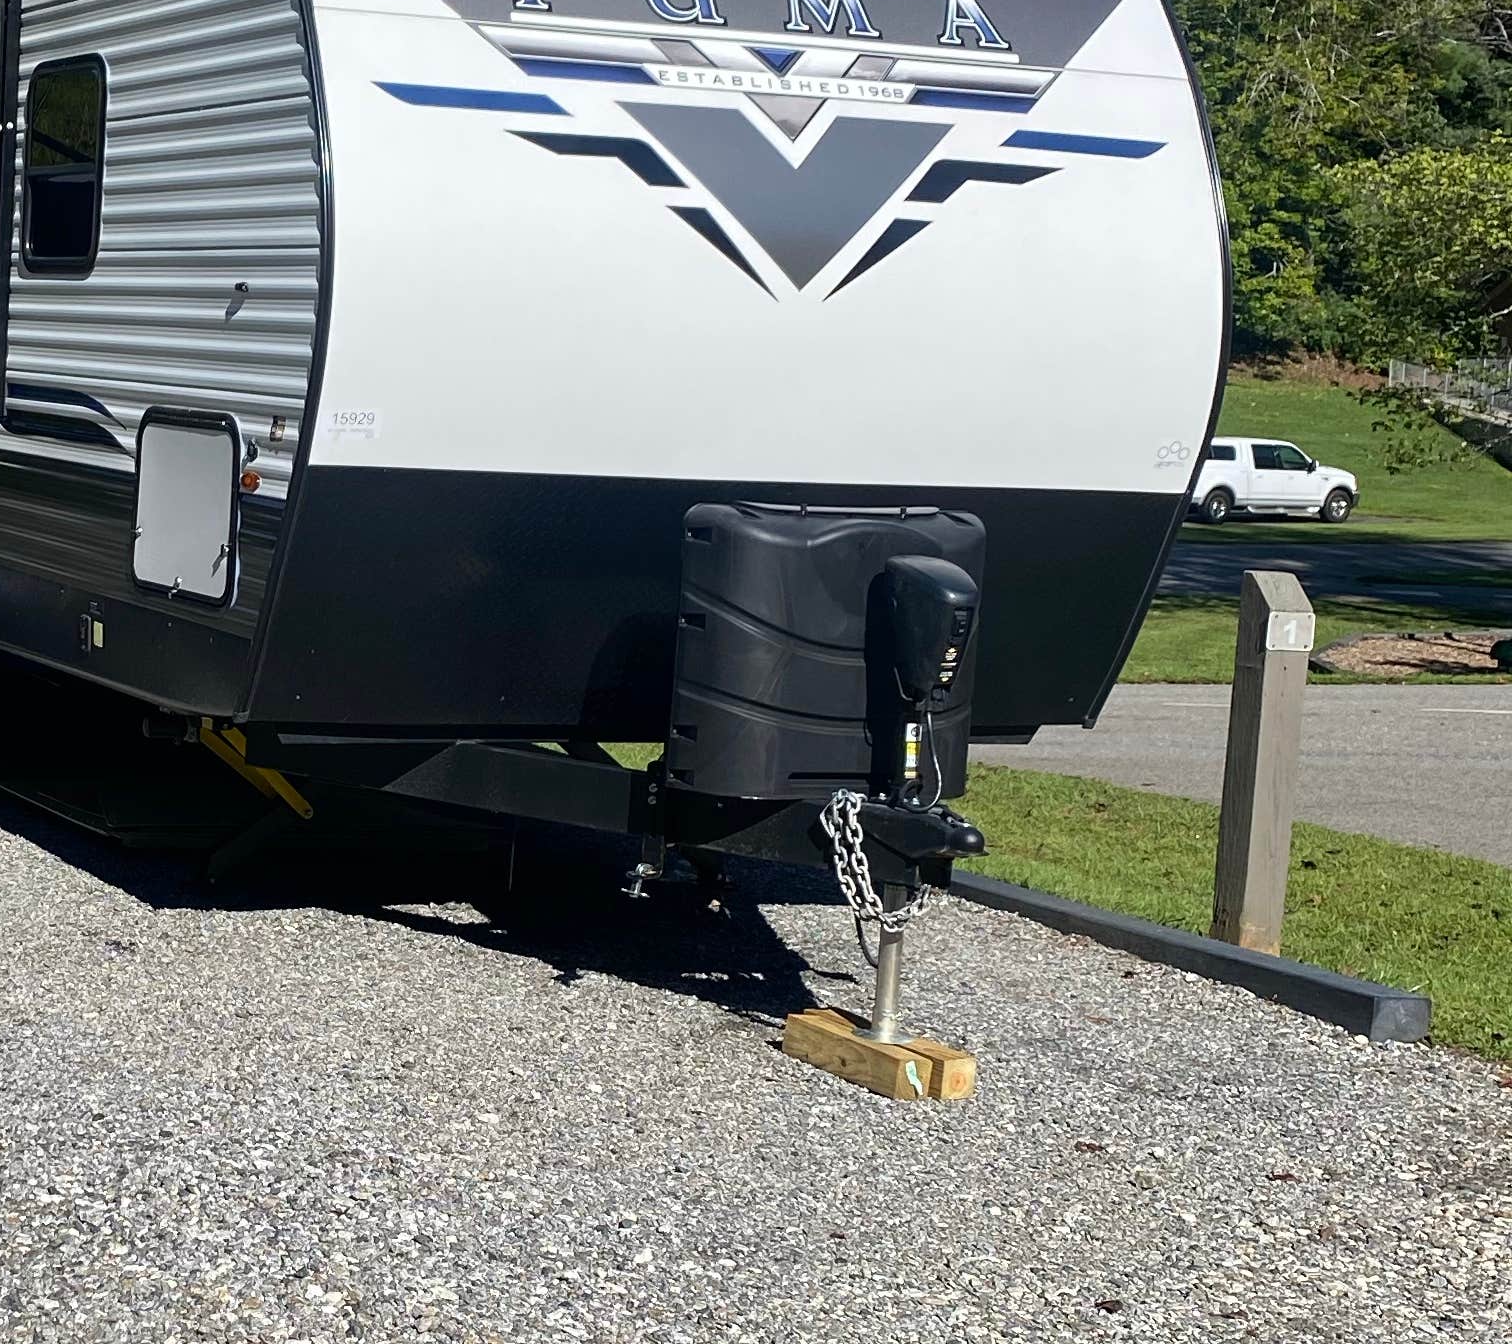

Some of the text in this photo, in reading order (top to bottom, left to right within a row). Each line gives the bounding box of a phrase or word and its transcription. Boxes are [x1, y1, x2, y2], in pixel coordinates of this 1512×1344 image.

[658, 69, 905, 100] ESTABLISHED 1968
[332, 412, 376, 425] 15929
[1283, 619, 1297, 645] 1
